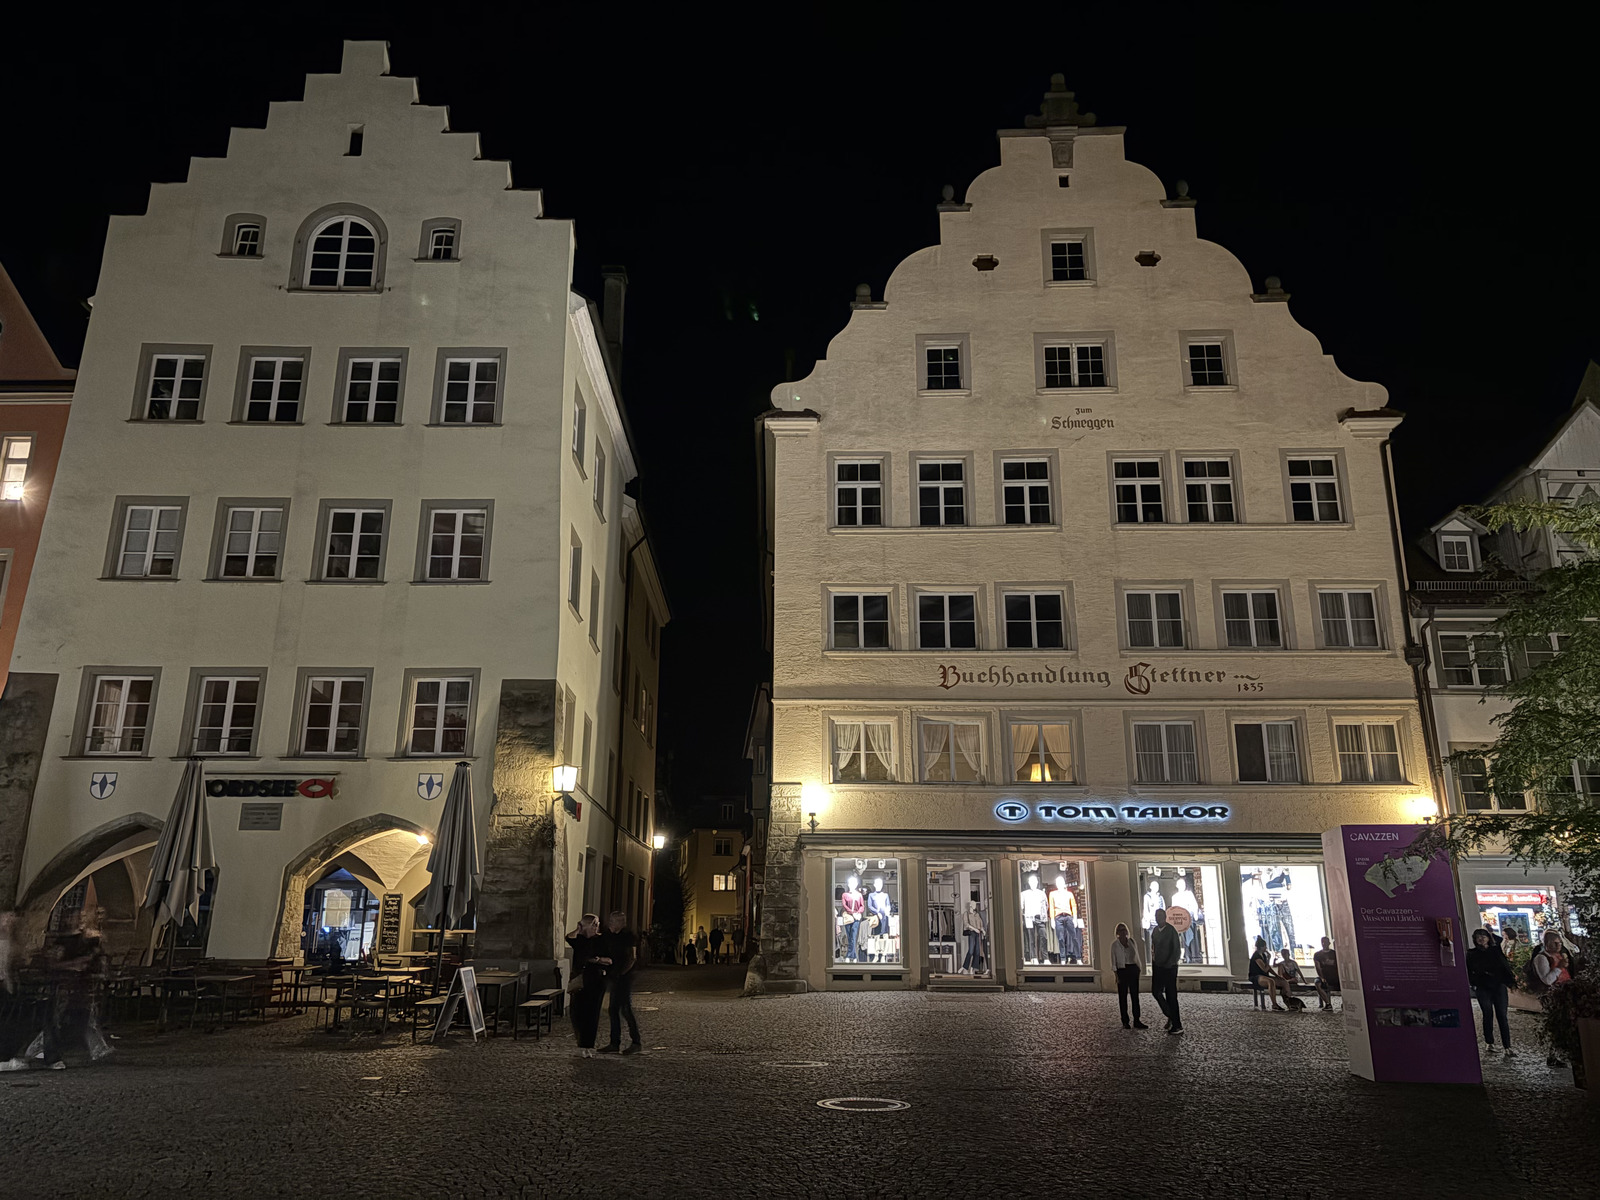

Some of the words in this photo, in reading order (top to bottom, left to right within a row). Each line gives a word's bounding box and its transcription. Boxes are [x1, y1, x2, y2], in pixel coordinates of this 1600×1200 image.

[1050, 415, 1115, 430] Schneggen
[937, 664, 1112, 691] Buchhandlung
[1123, 661, 1227, 695] Stettner
[1237, 681, 1264, 693] 1835
[1038, 806, 1117, 819] TOM
[1121, 806, 1229, 819] TAILOR
[1349, 832, 1399, 841] CAVAZZEN
[1360, 907, 1375, 915] Der
[1375, 907, 1413, 915] Cavazzen
